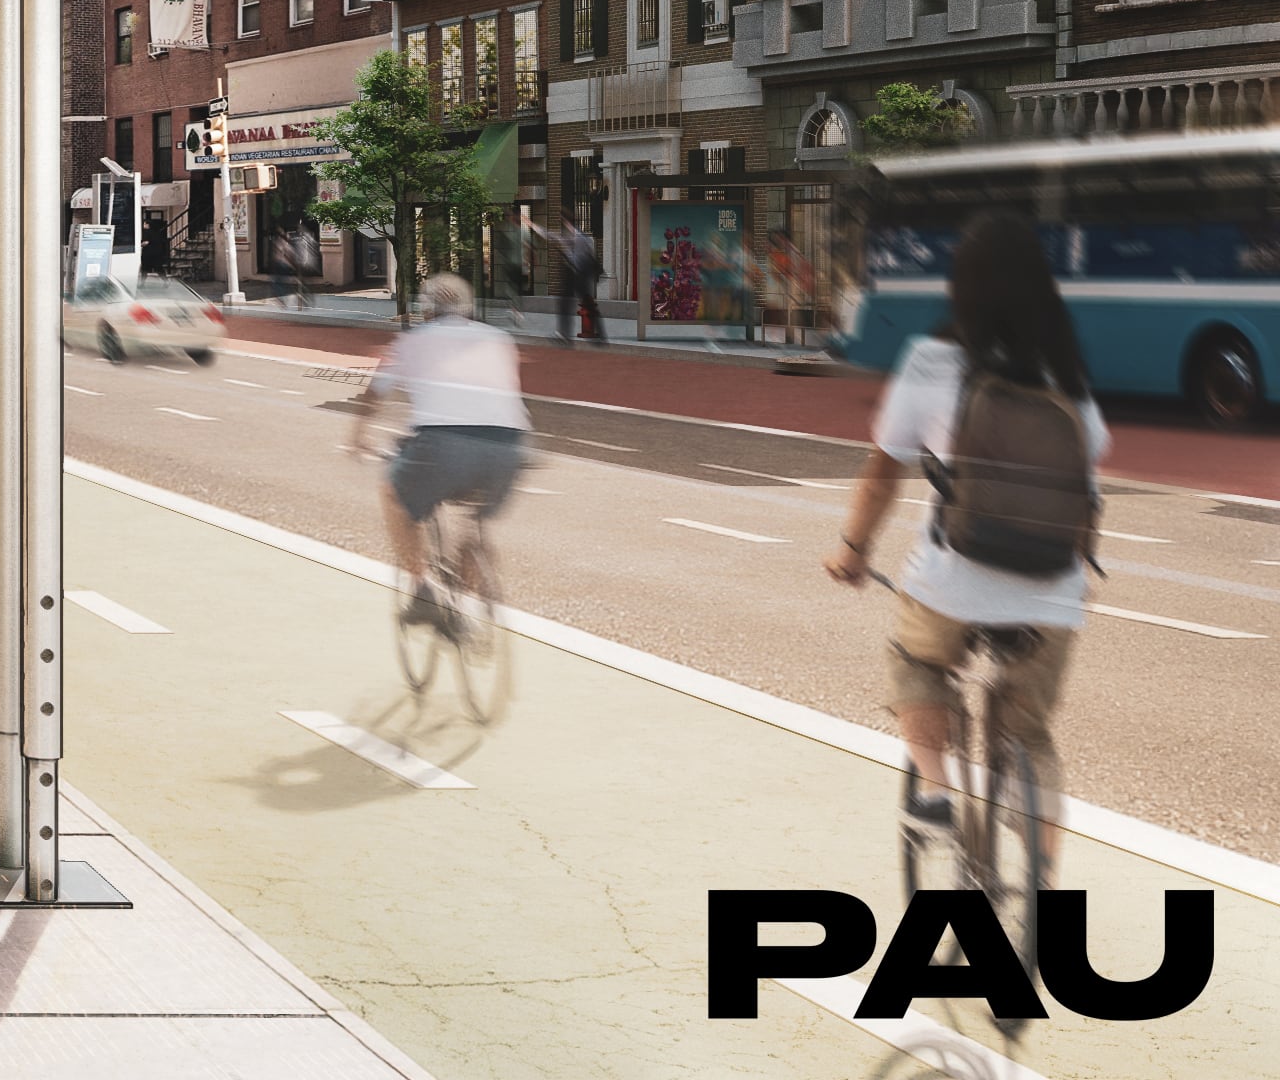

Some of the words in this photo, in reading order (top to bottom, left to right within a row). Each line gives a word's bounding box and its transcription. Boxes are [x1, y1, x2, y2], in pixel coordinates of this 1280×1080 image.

[192, 3, 204, 41] BHAVAN
[248, 150, 280, 159] VEGETARIAN
[281, 146, 318, 157] RESTAURANT
[718, 219, 737, 228] PURE
